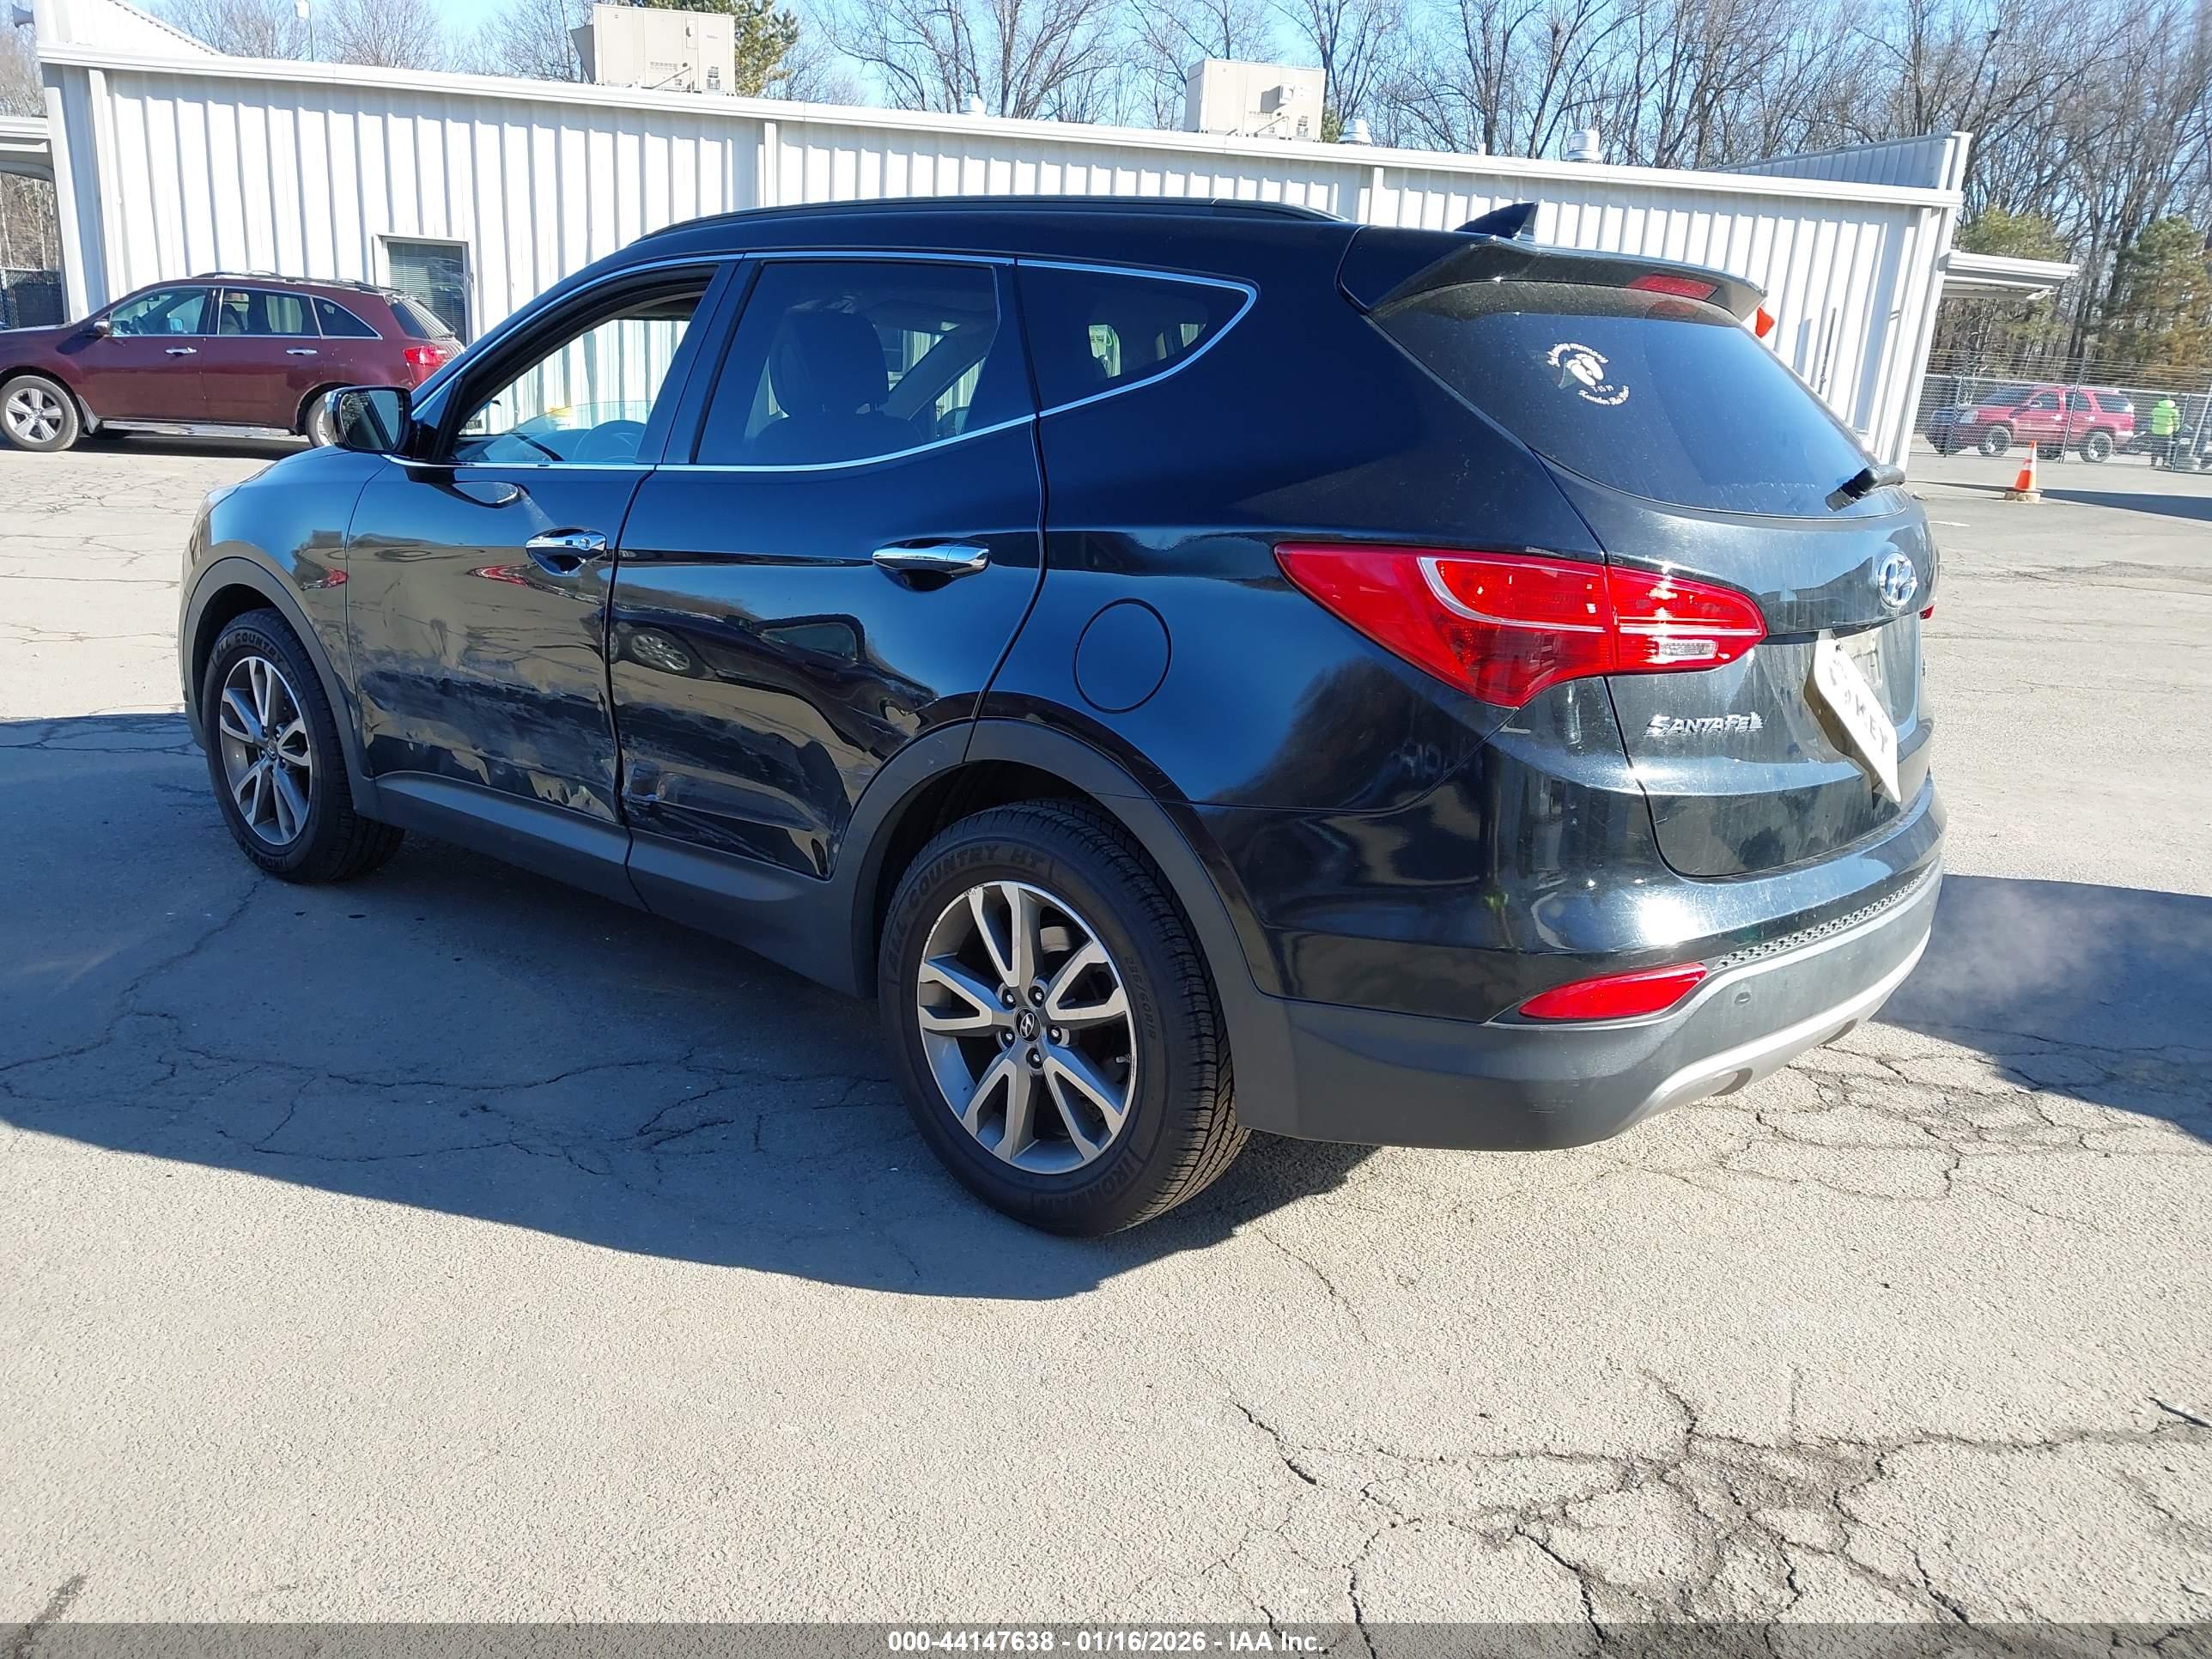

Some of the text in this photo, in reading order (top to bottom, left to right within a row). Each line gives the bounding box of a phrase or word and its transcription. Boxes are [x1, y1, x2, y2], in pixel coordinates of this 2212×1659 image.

[234, 632, 283, 663] COUNTRY
[908, 845, 1000, 908] COUNTRY
[1009, 846, 1045, 868] HT
